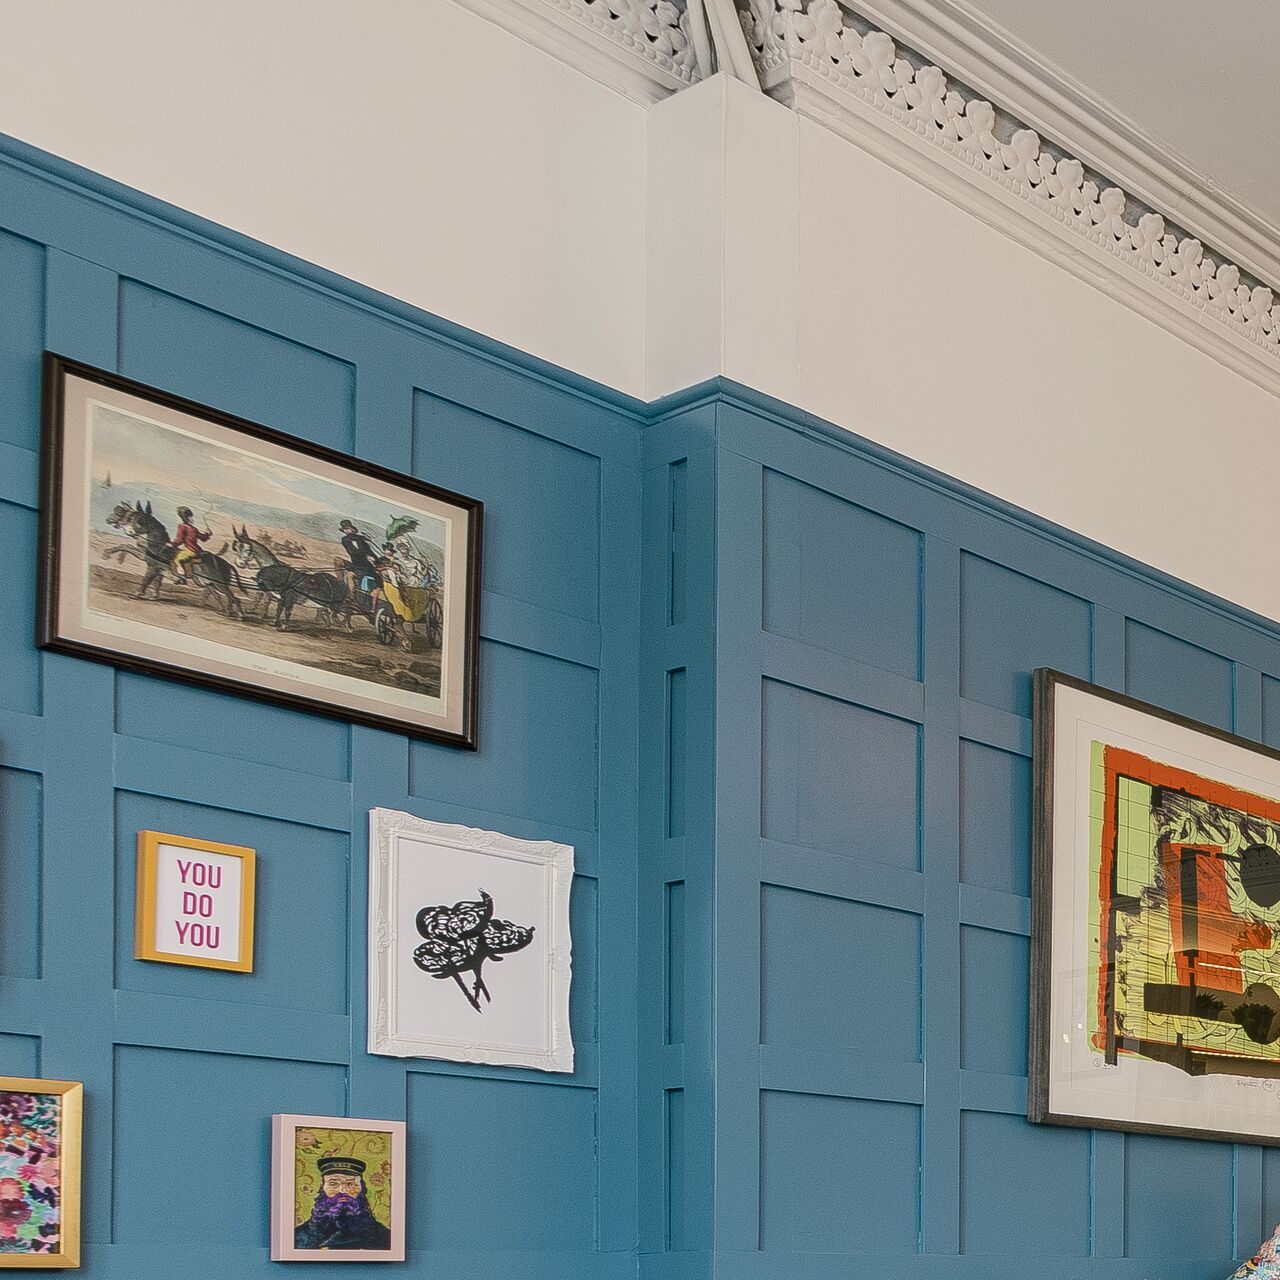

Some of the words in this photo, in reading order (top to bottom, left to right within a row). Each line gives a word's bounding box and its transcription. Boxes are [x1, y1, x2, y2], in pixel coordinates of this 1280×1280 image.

[176, 859, 222, 889] YOU
[183, 891, 213, 918] DO
[175, 920, 220, 949] YOU
